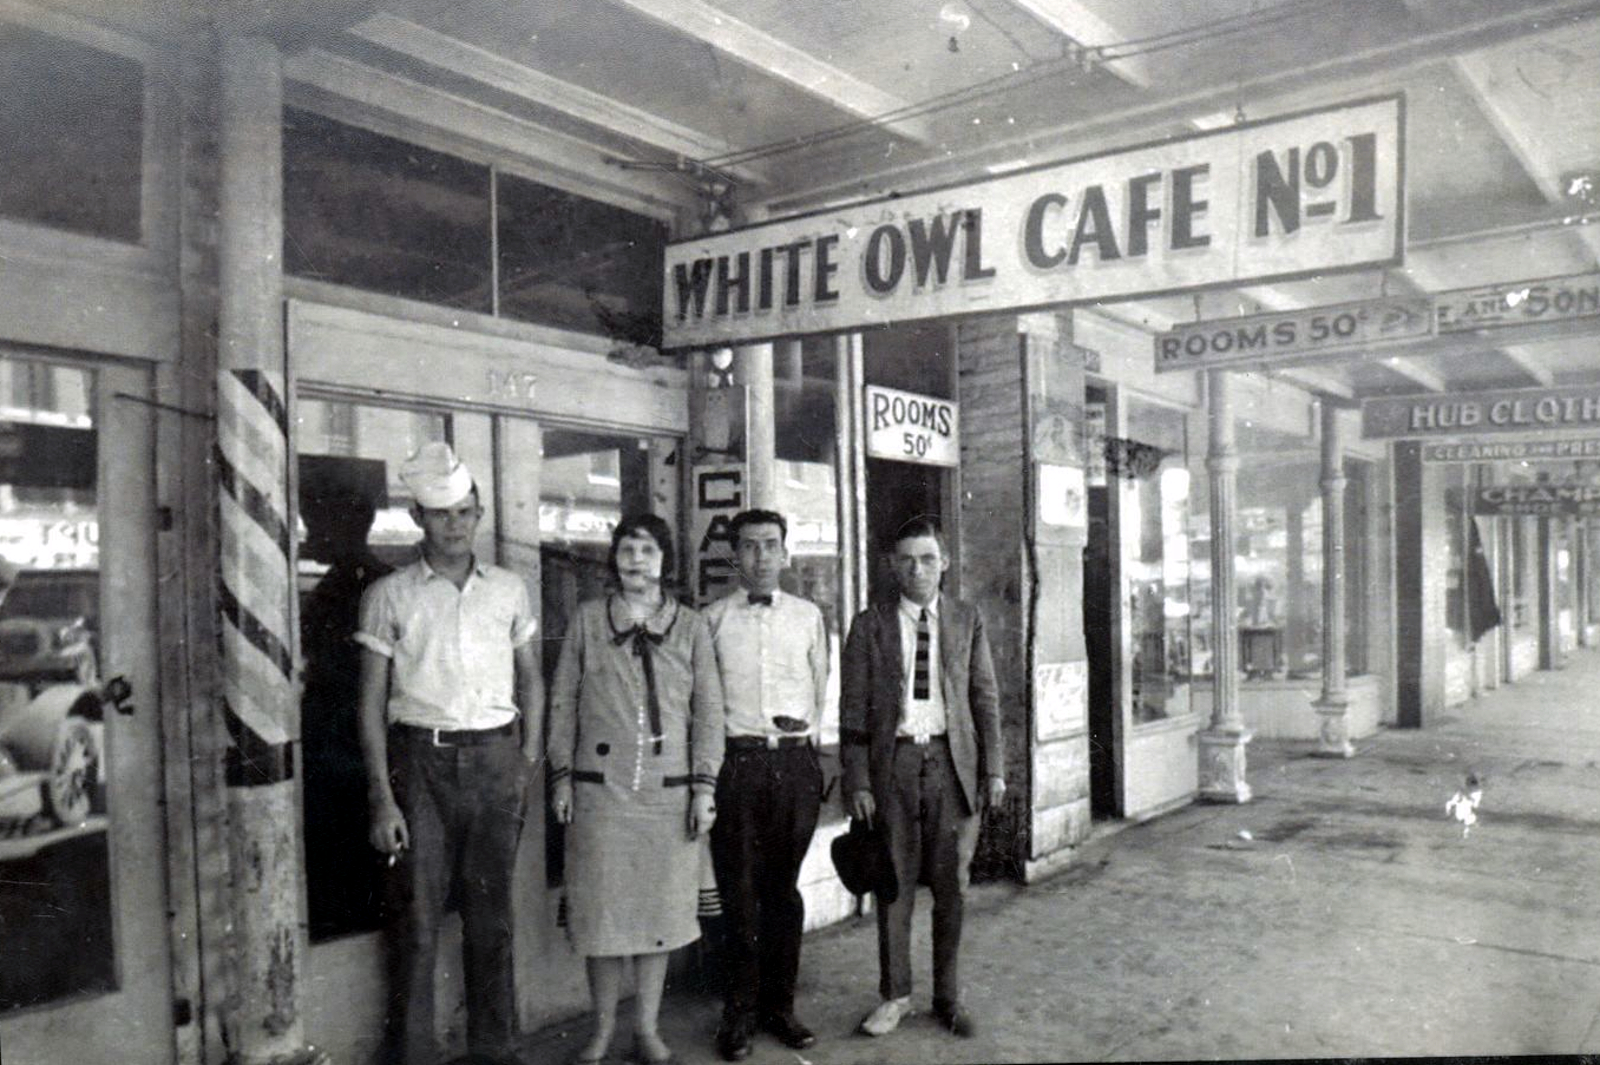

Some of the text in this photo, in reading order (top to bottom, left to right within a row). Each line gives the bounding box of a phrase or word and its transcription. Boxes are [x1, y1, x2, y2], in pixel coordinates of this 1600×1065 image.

[674, 234, 840, 321] WHITE
[863, 207, 997, 293] OWL
[1022, 163, 1211, 269] CAFE
[1161, 321, 1297, 360] ROOMS
[872, 392, 952, 438] ROOMS
[1410, 403, 1481, 429] HUB
[698, 471, 741, 608] CAF
